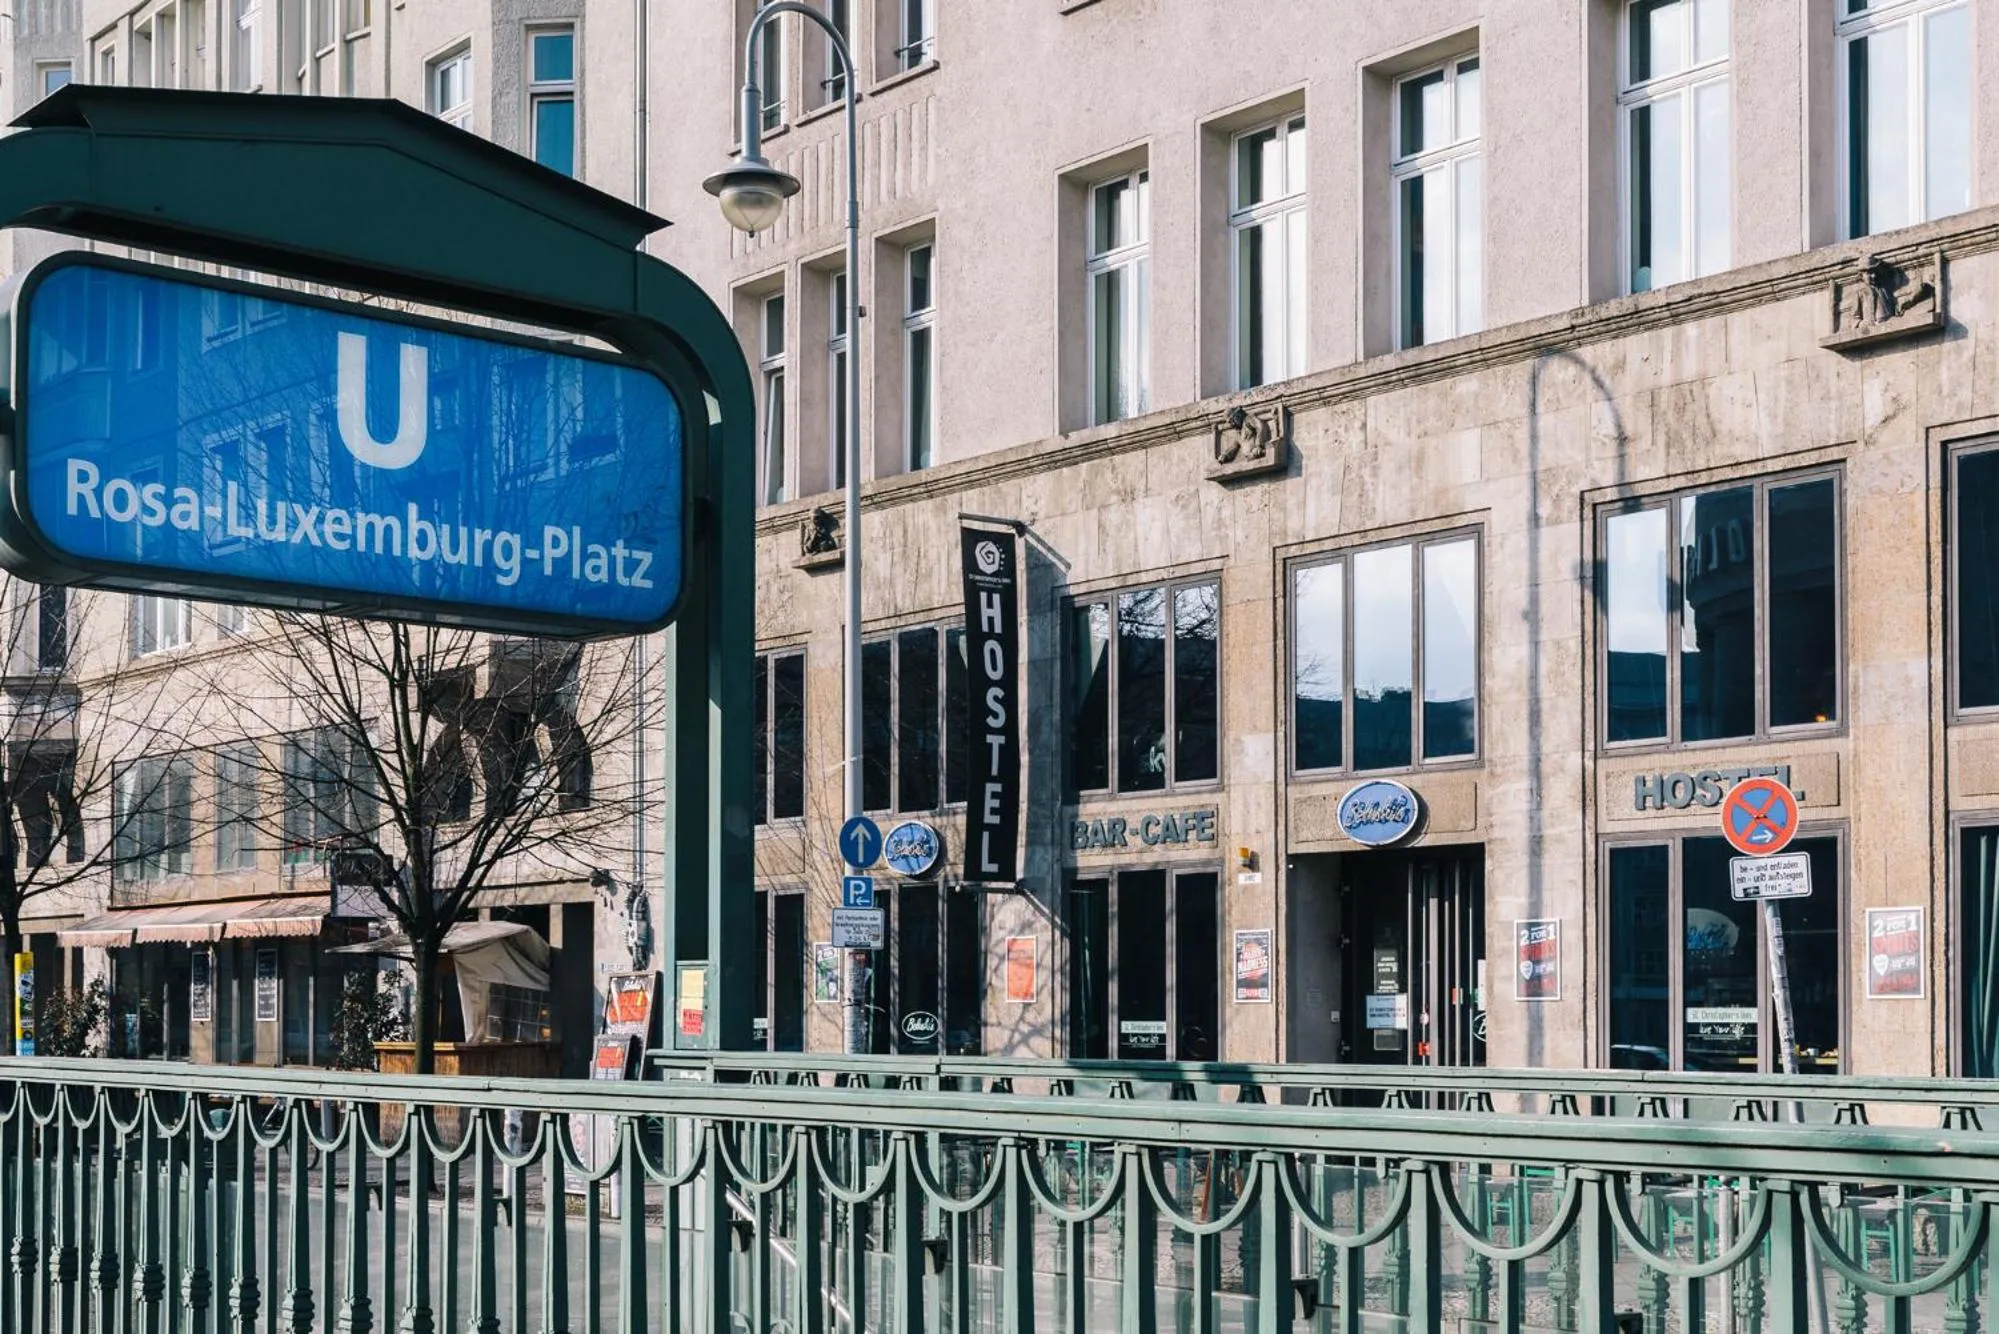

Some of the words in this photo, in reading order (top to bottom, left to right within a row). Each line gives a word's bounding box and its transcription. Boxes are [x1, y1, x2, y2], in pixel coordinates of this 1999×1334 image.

[338, 331, 428, 469] U
[66, 457, 654, 589] Rosa-Luxemburg-Platz
[980, 591, 1006, 873] HOSTEL
[850, 880, 866, 904] P
[1520, 929, 1530, 946] 2
